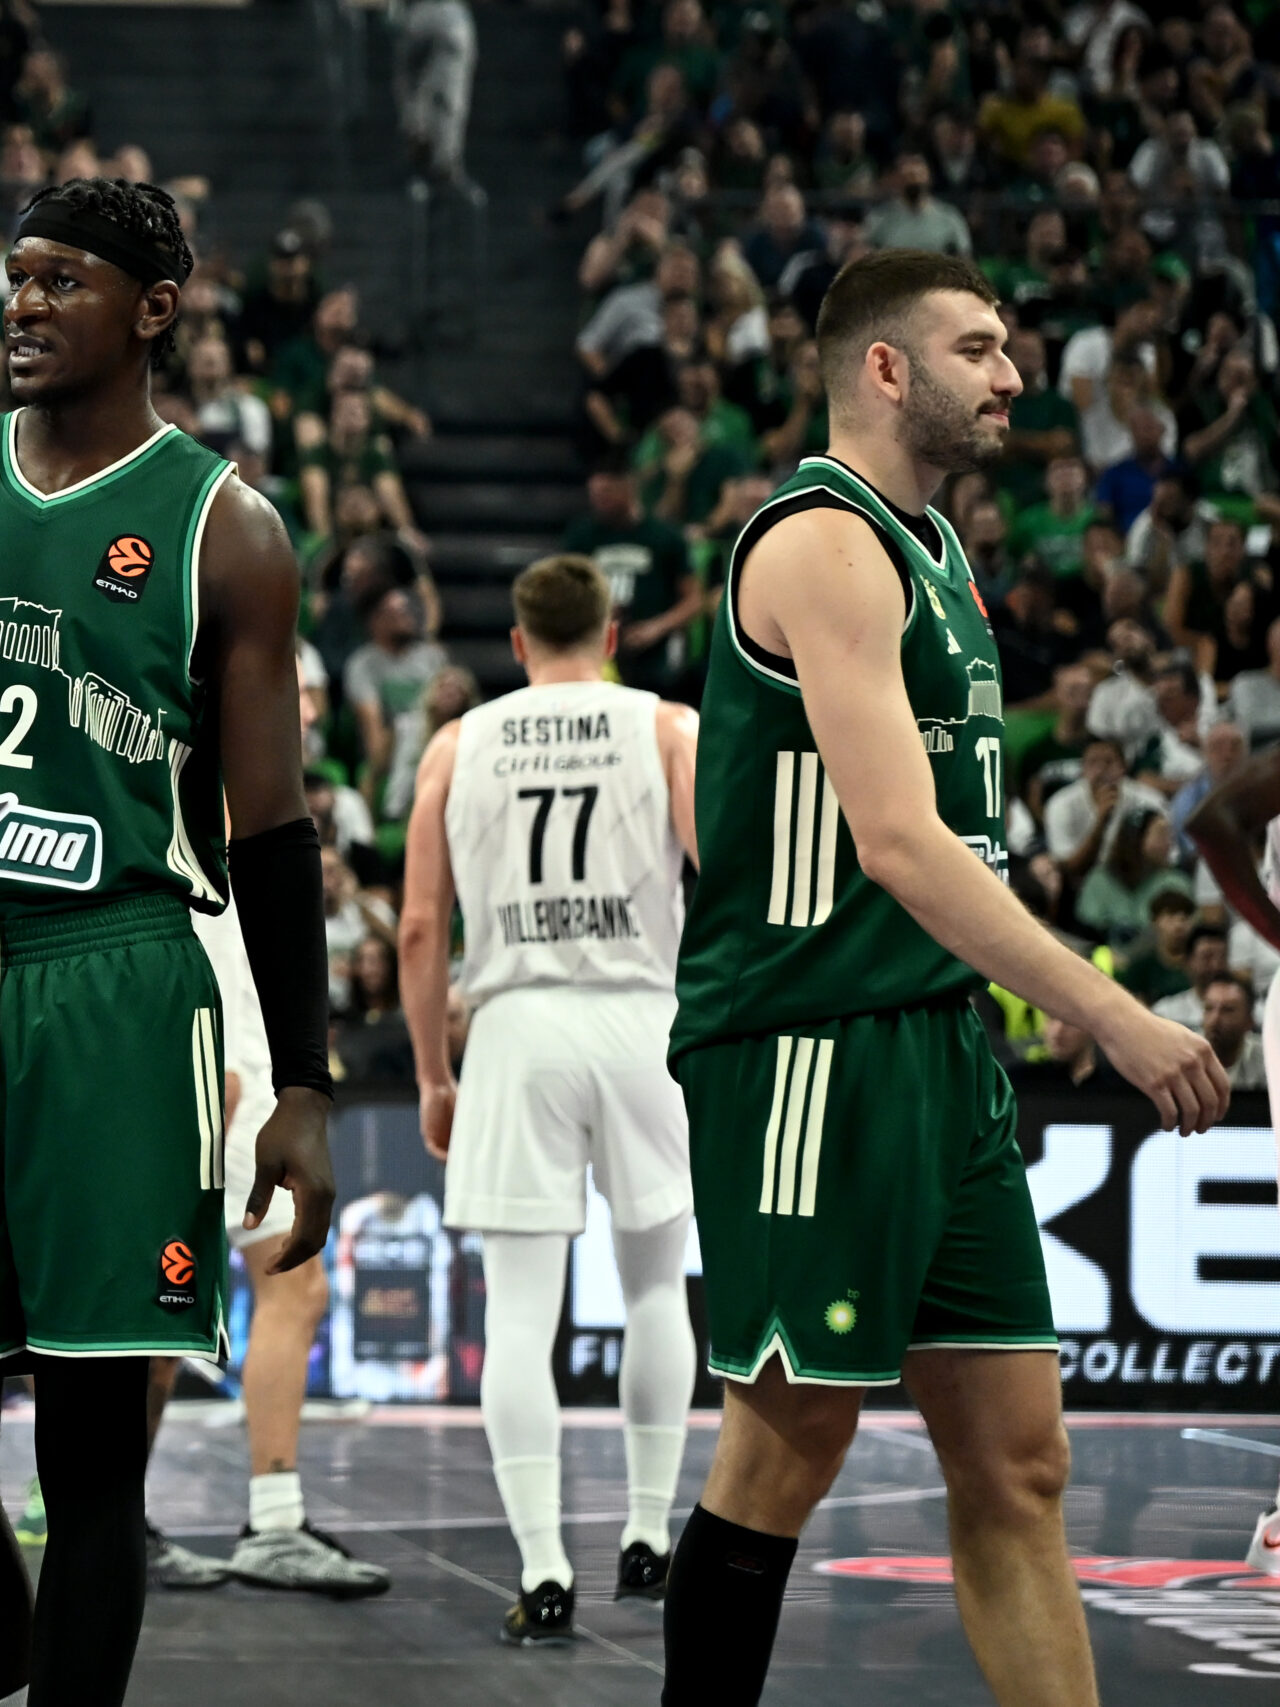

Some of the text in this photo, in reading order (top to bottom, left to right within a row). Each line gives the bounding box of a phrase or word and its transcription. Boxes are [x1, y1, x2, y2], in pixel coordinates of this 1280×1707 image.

[95, 578, 138, 599] ETIHAD
[501, 711, 611, 747] SESTINA
[974, 736, 1001, 818] 17
[517, 784, 599, 884] 77
[159, 1295, 195, 1304] ETIHAD
